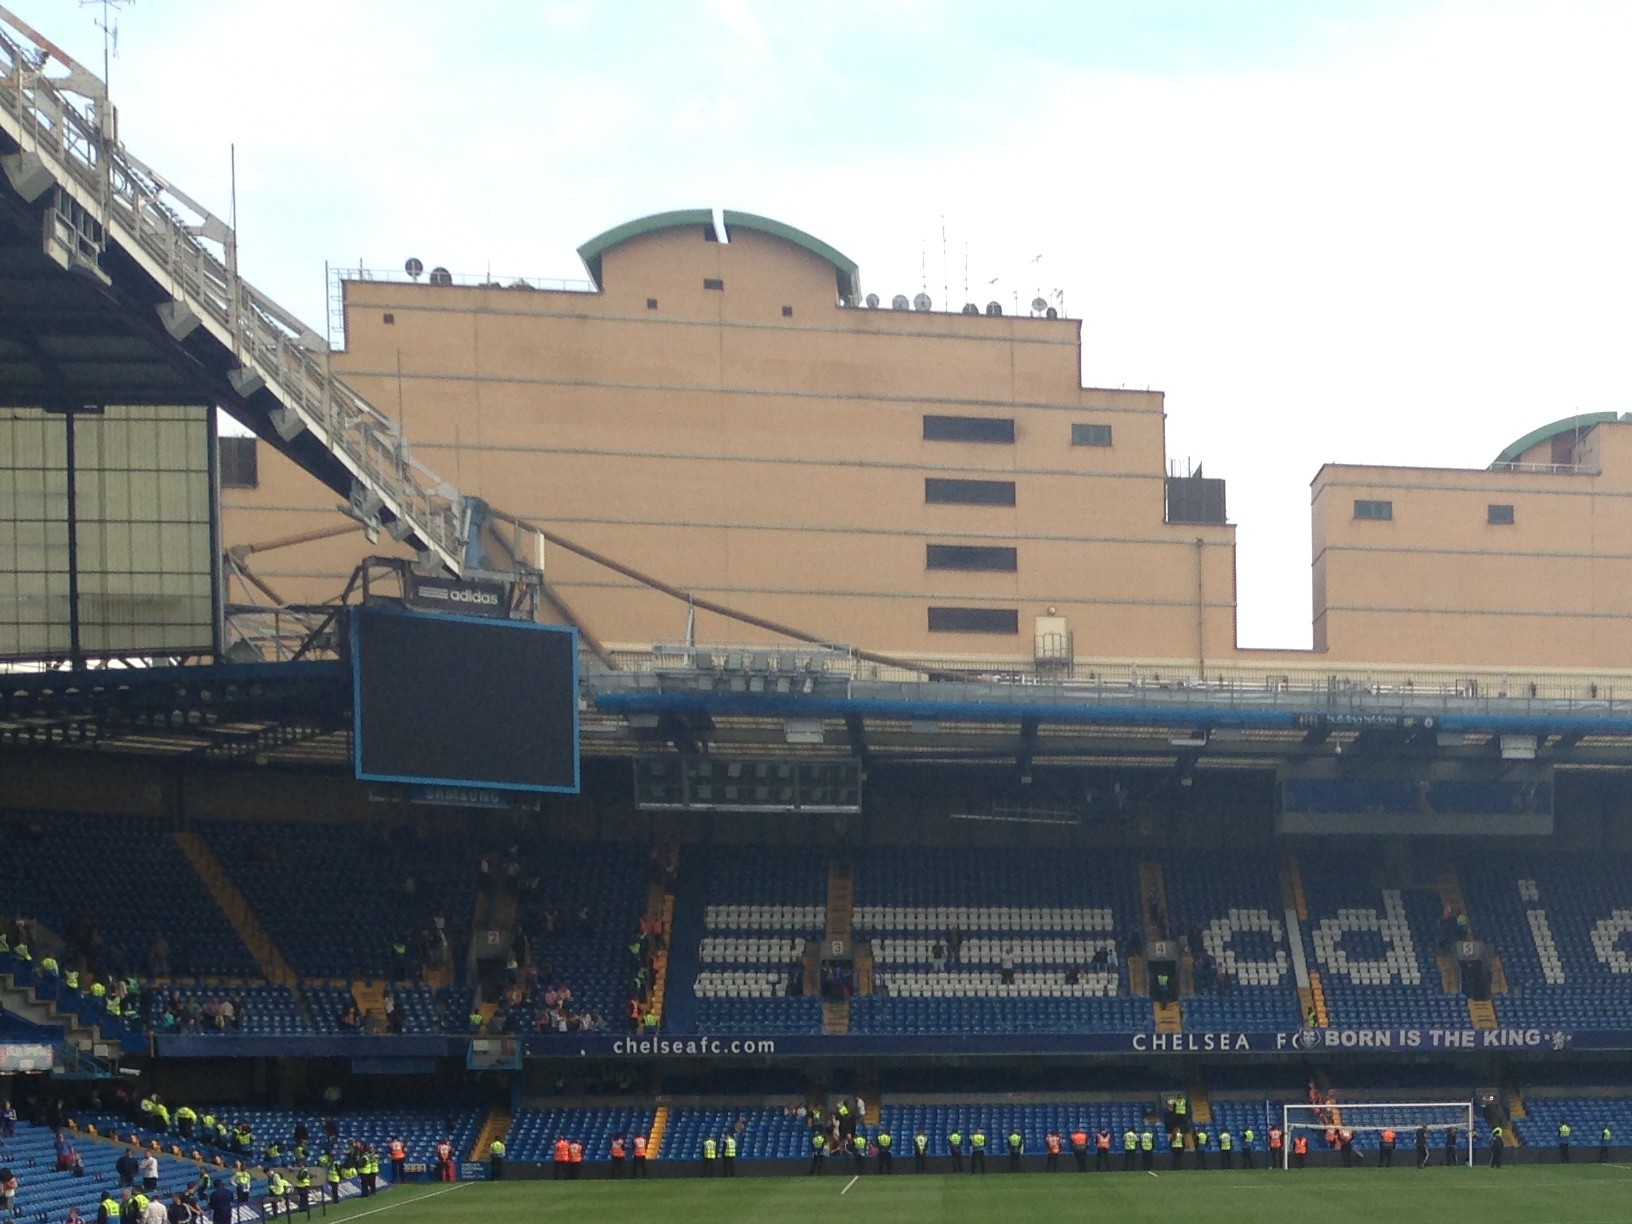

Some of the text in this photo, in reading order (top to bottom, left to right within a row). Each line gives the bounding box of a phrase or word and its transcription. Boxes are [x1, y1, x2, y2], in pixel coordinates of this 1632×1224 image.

[450, 589, 498, 605] adidas
[613, 1037, 775, 1054] chelseafc.com
[1132, 1034, 1250, 1051] CHELSEA
[1325, 1029, 1540, 1047] BORN IS THE KING
